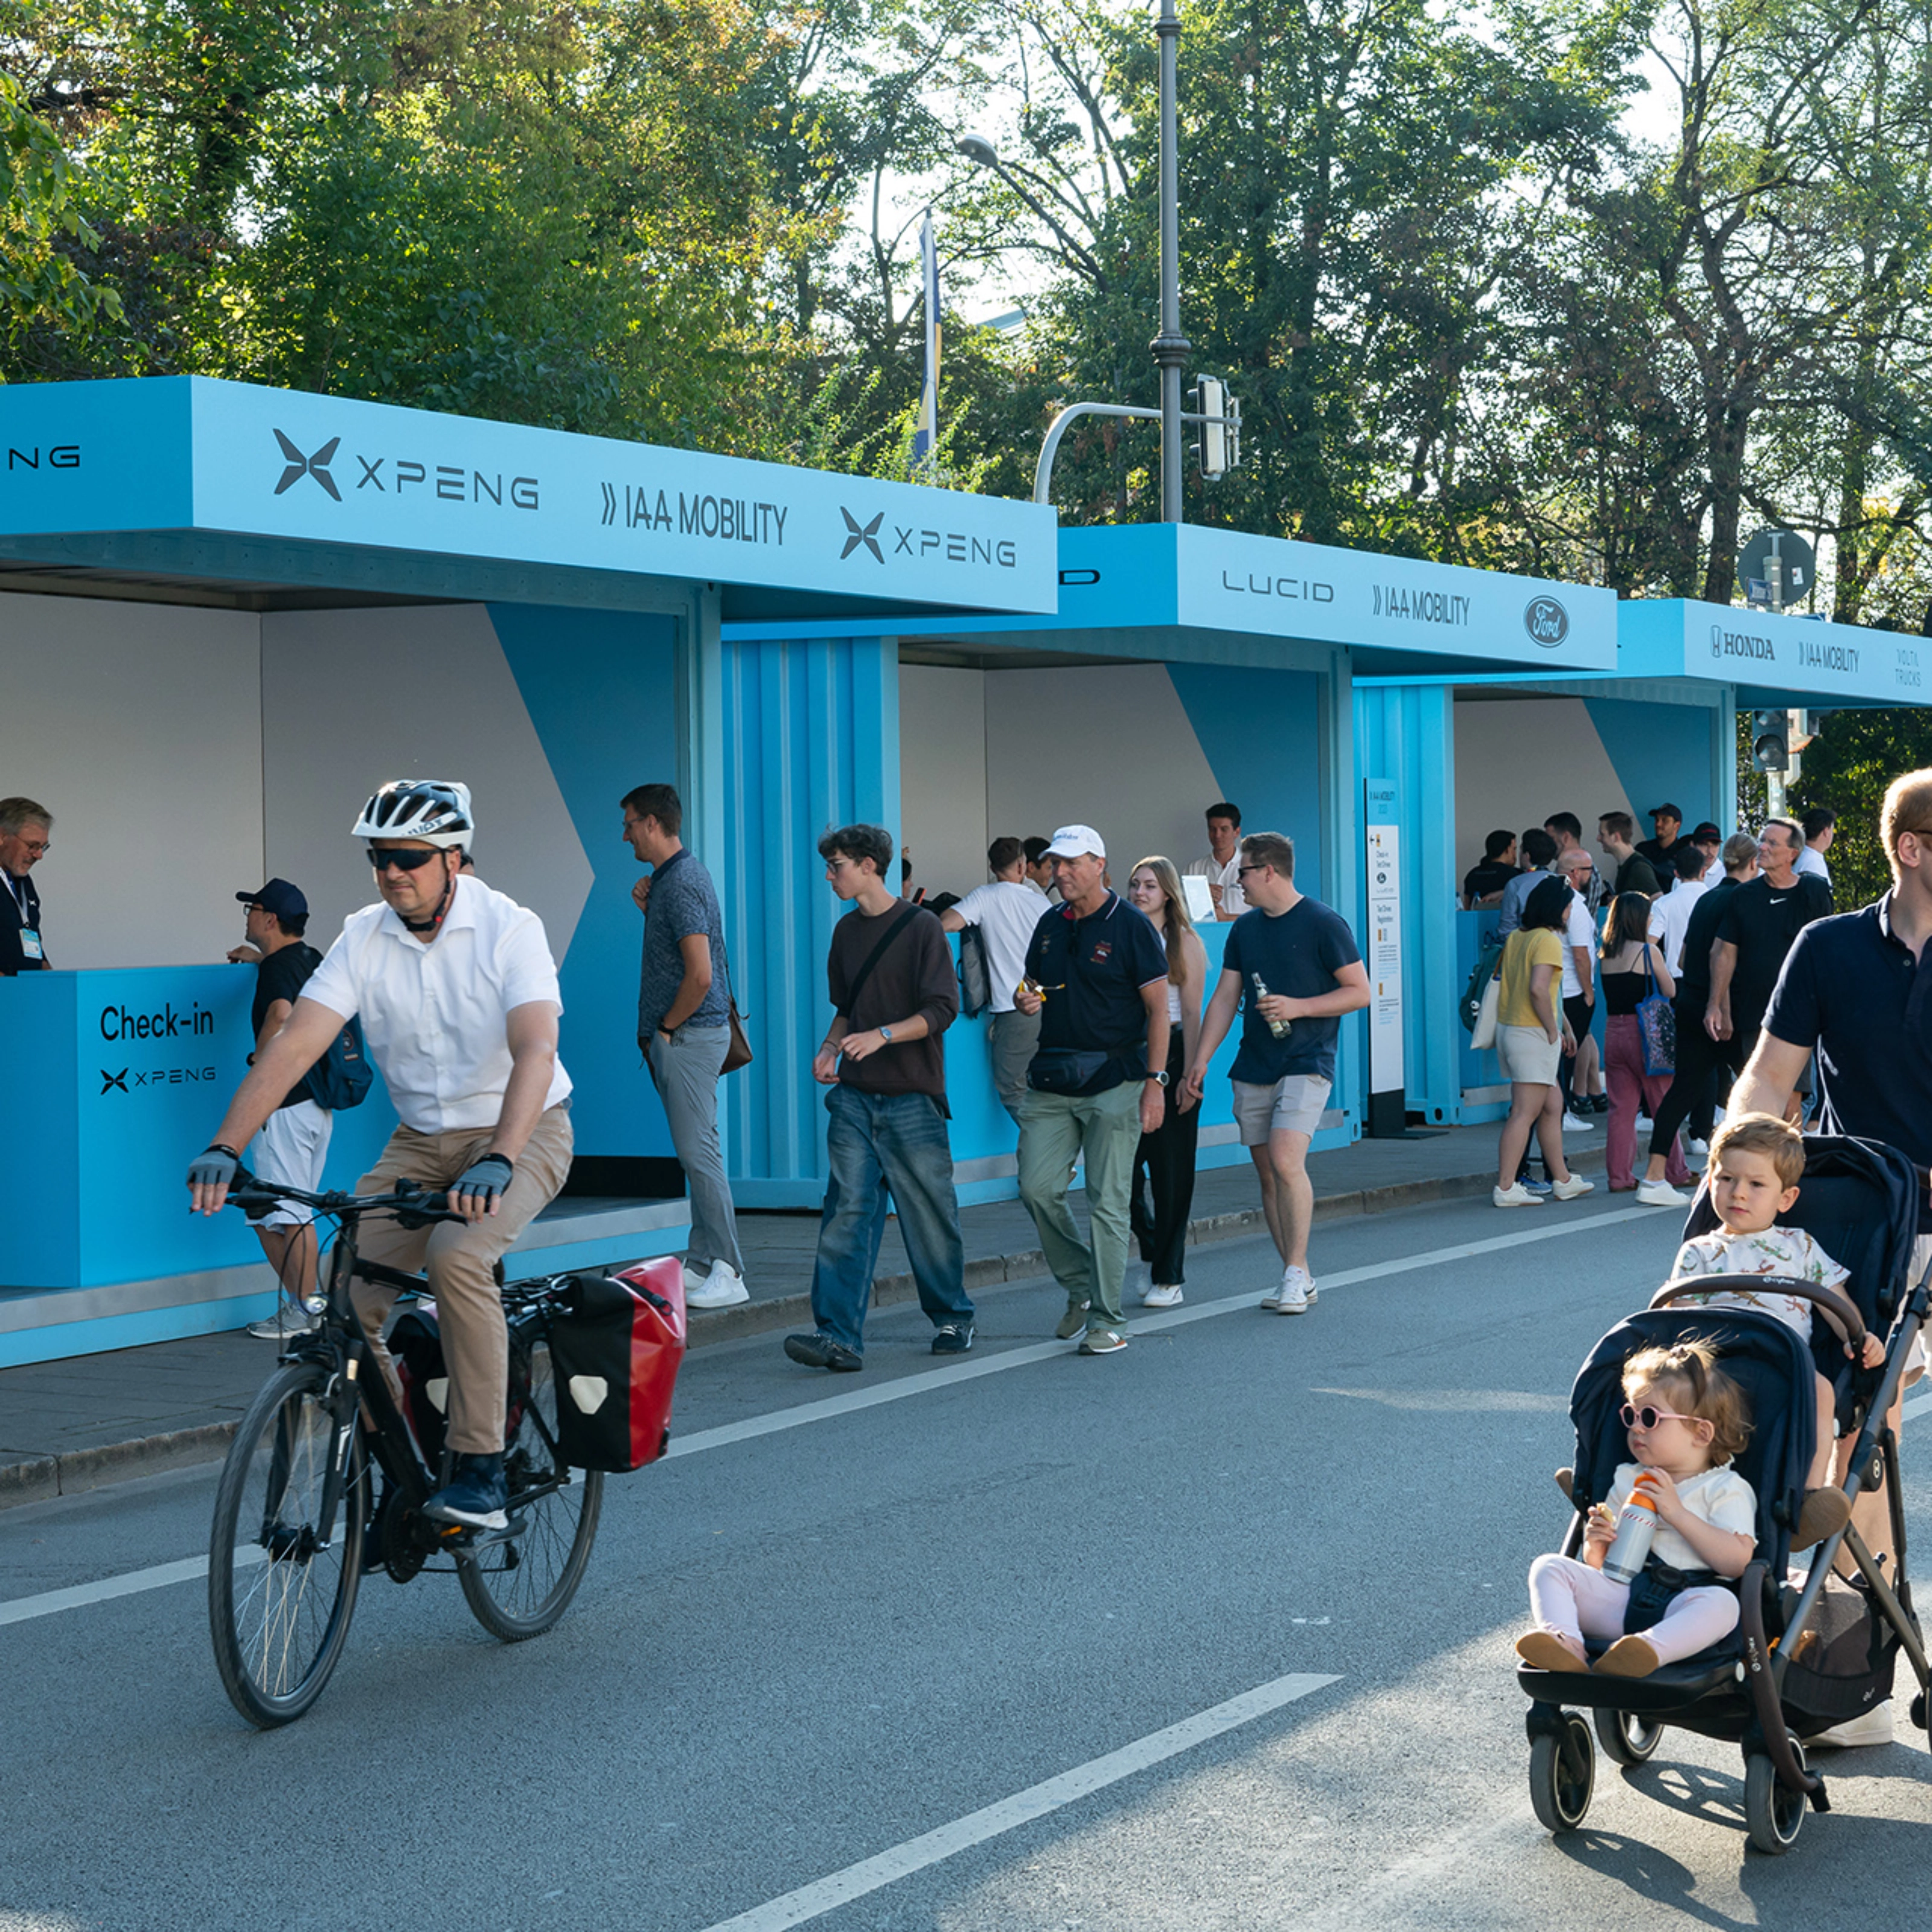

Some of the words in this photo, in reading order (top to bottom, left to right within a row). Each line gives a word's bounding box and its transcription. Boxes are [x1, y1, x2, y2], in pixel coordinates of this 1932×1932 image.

[356, 455, 539, 510] XPENG
[625, 485, 673, 532] IAA
[679, 492, 788, 546] MOBILITY
[894, 526, 1016, 568] XPENG
[1223, 570, 1334, 603] LUCID
[1385, 586, 1410, 618] IAA
[1412, 589, 1471, 625] MOBILITY
[1532, 603, 1562, 639] Ford
[1724, 632, 1776, 661] HONDA
[1823, 645, 1860, 673] MOBILITY
[101, 1001, 214, 1040] Check-in
[135, 1066, 216, 1086] XPENG
